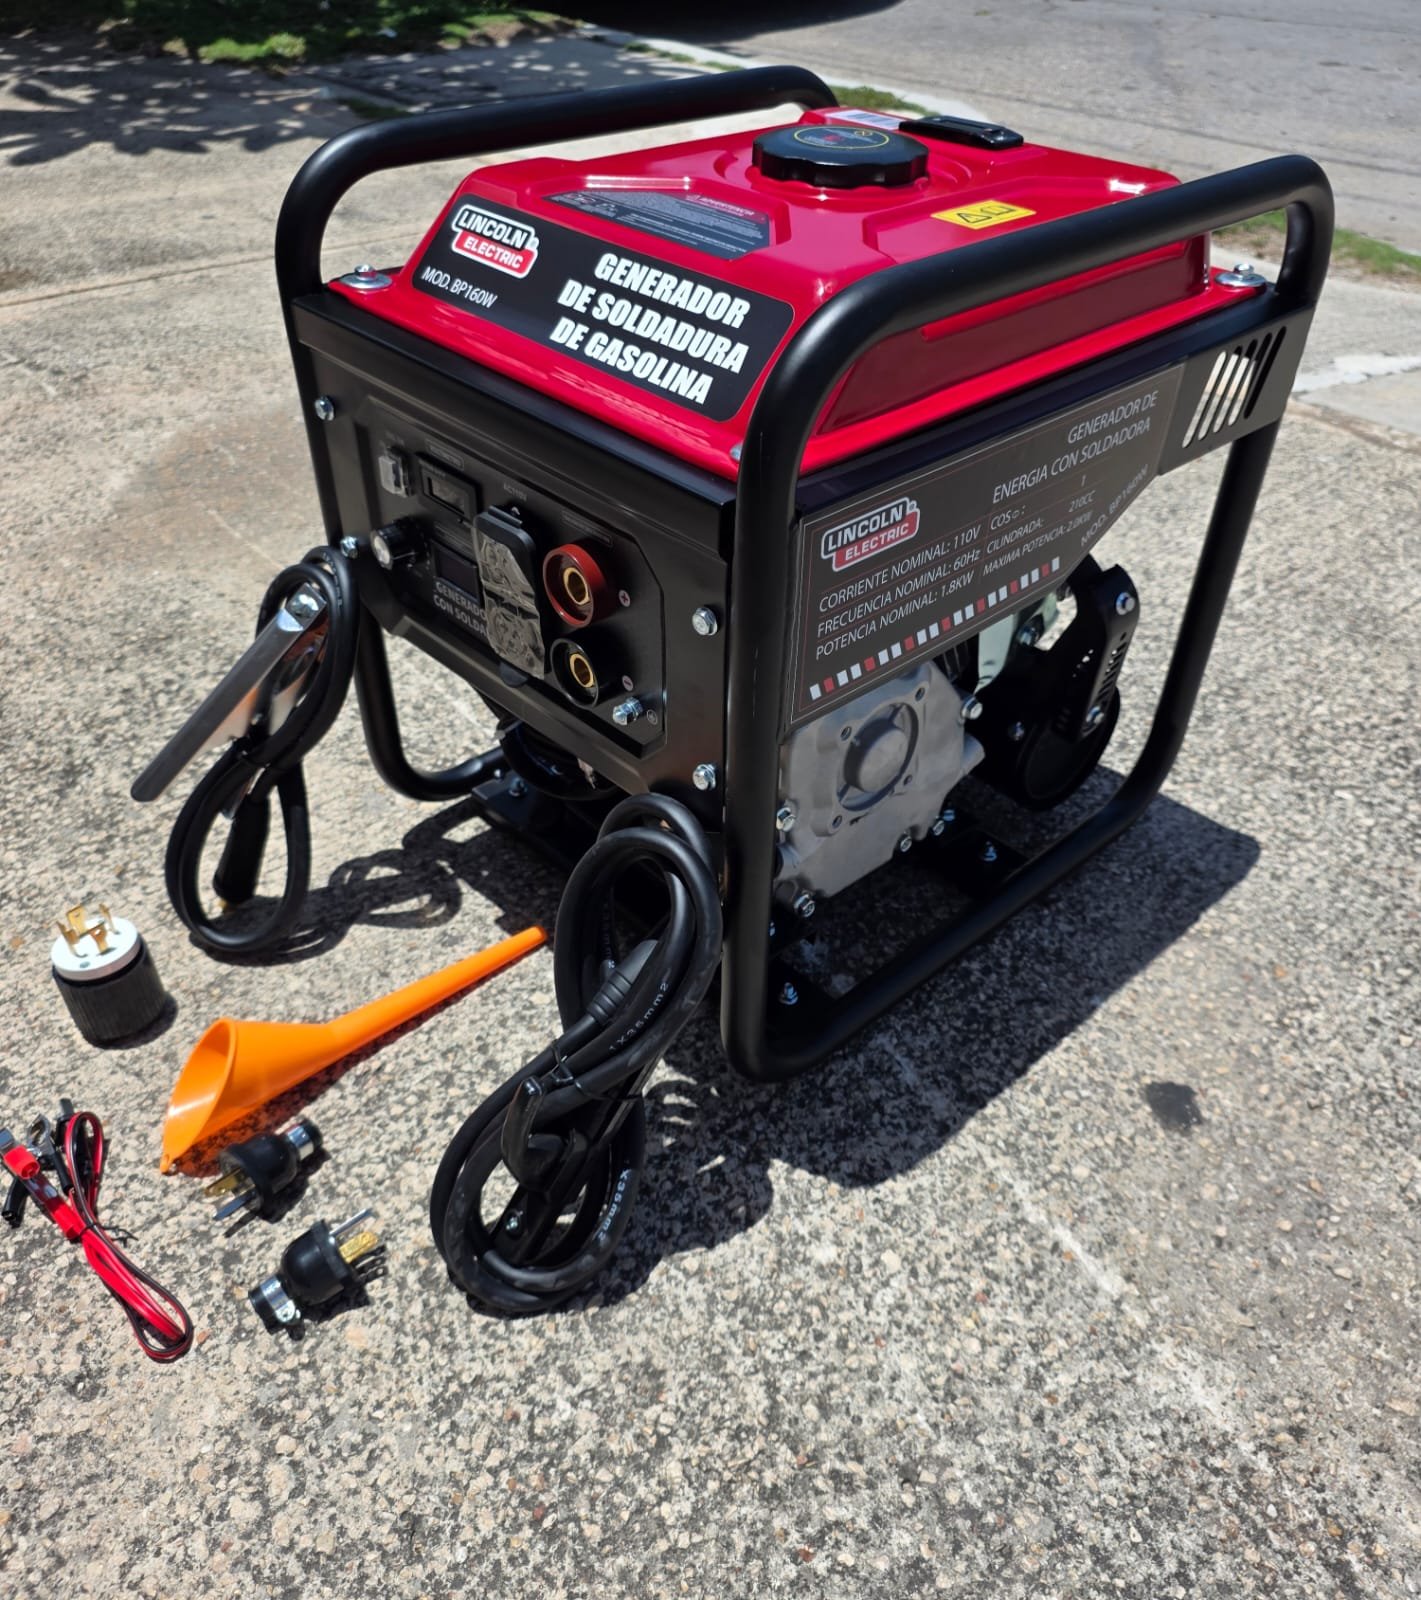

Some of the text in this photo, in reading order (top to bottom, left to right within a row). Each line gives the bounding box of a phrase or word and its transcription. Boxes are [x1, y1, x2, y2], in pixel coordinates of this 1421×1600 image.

[458, 210, 528, 249] LINCOLN
[463, 236, 523, 269] ELECTRIC
[421, 266, 498, 308] MOD. BP160W
[594, 252, 750, 329] GENERADOR
[557, 279, 749, 374] DE SOLDADURA
[550, 316, 713, 405] DE GASOLINA
[1068, 390, 1158, 444] GENERADOR DE
[993, 417, 1150, 504] ENERGIA CON SOLDADORA
[828, 504, 904, 552] LINCOLN
[845, 523, 909, 561] ELECTRIC
[819, 525, 982, 612] CORRIENTE NOMINAL: 110V
[983, 546, 1020, 577] MAXIMA
[433, 595, 487, 635] CON SOLDA
[434, 581, 487, 620] GENERADO
[816, 570, 974, 660] POTENCIA NOMINAL: 1.8KW
[817, 549, 981, 638] FRECUENCIA NOMINAL: 60Hz
